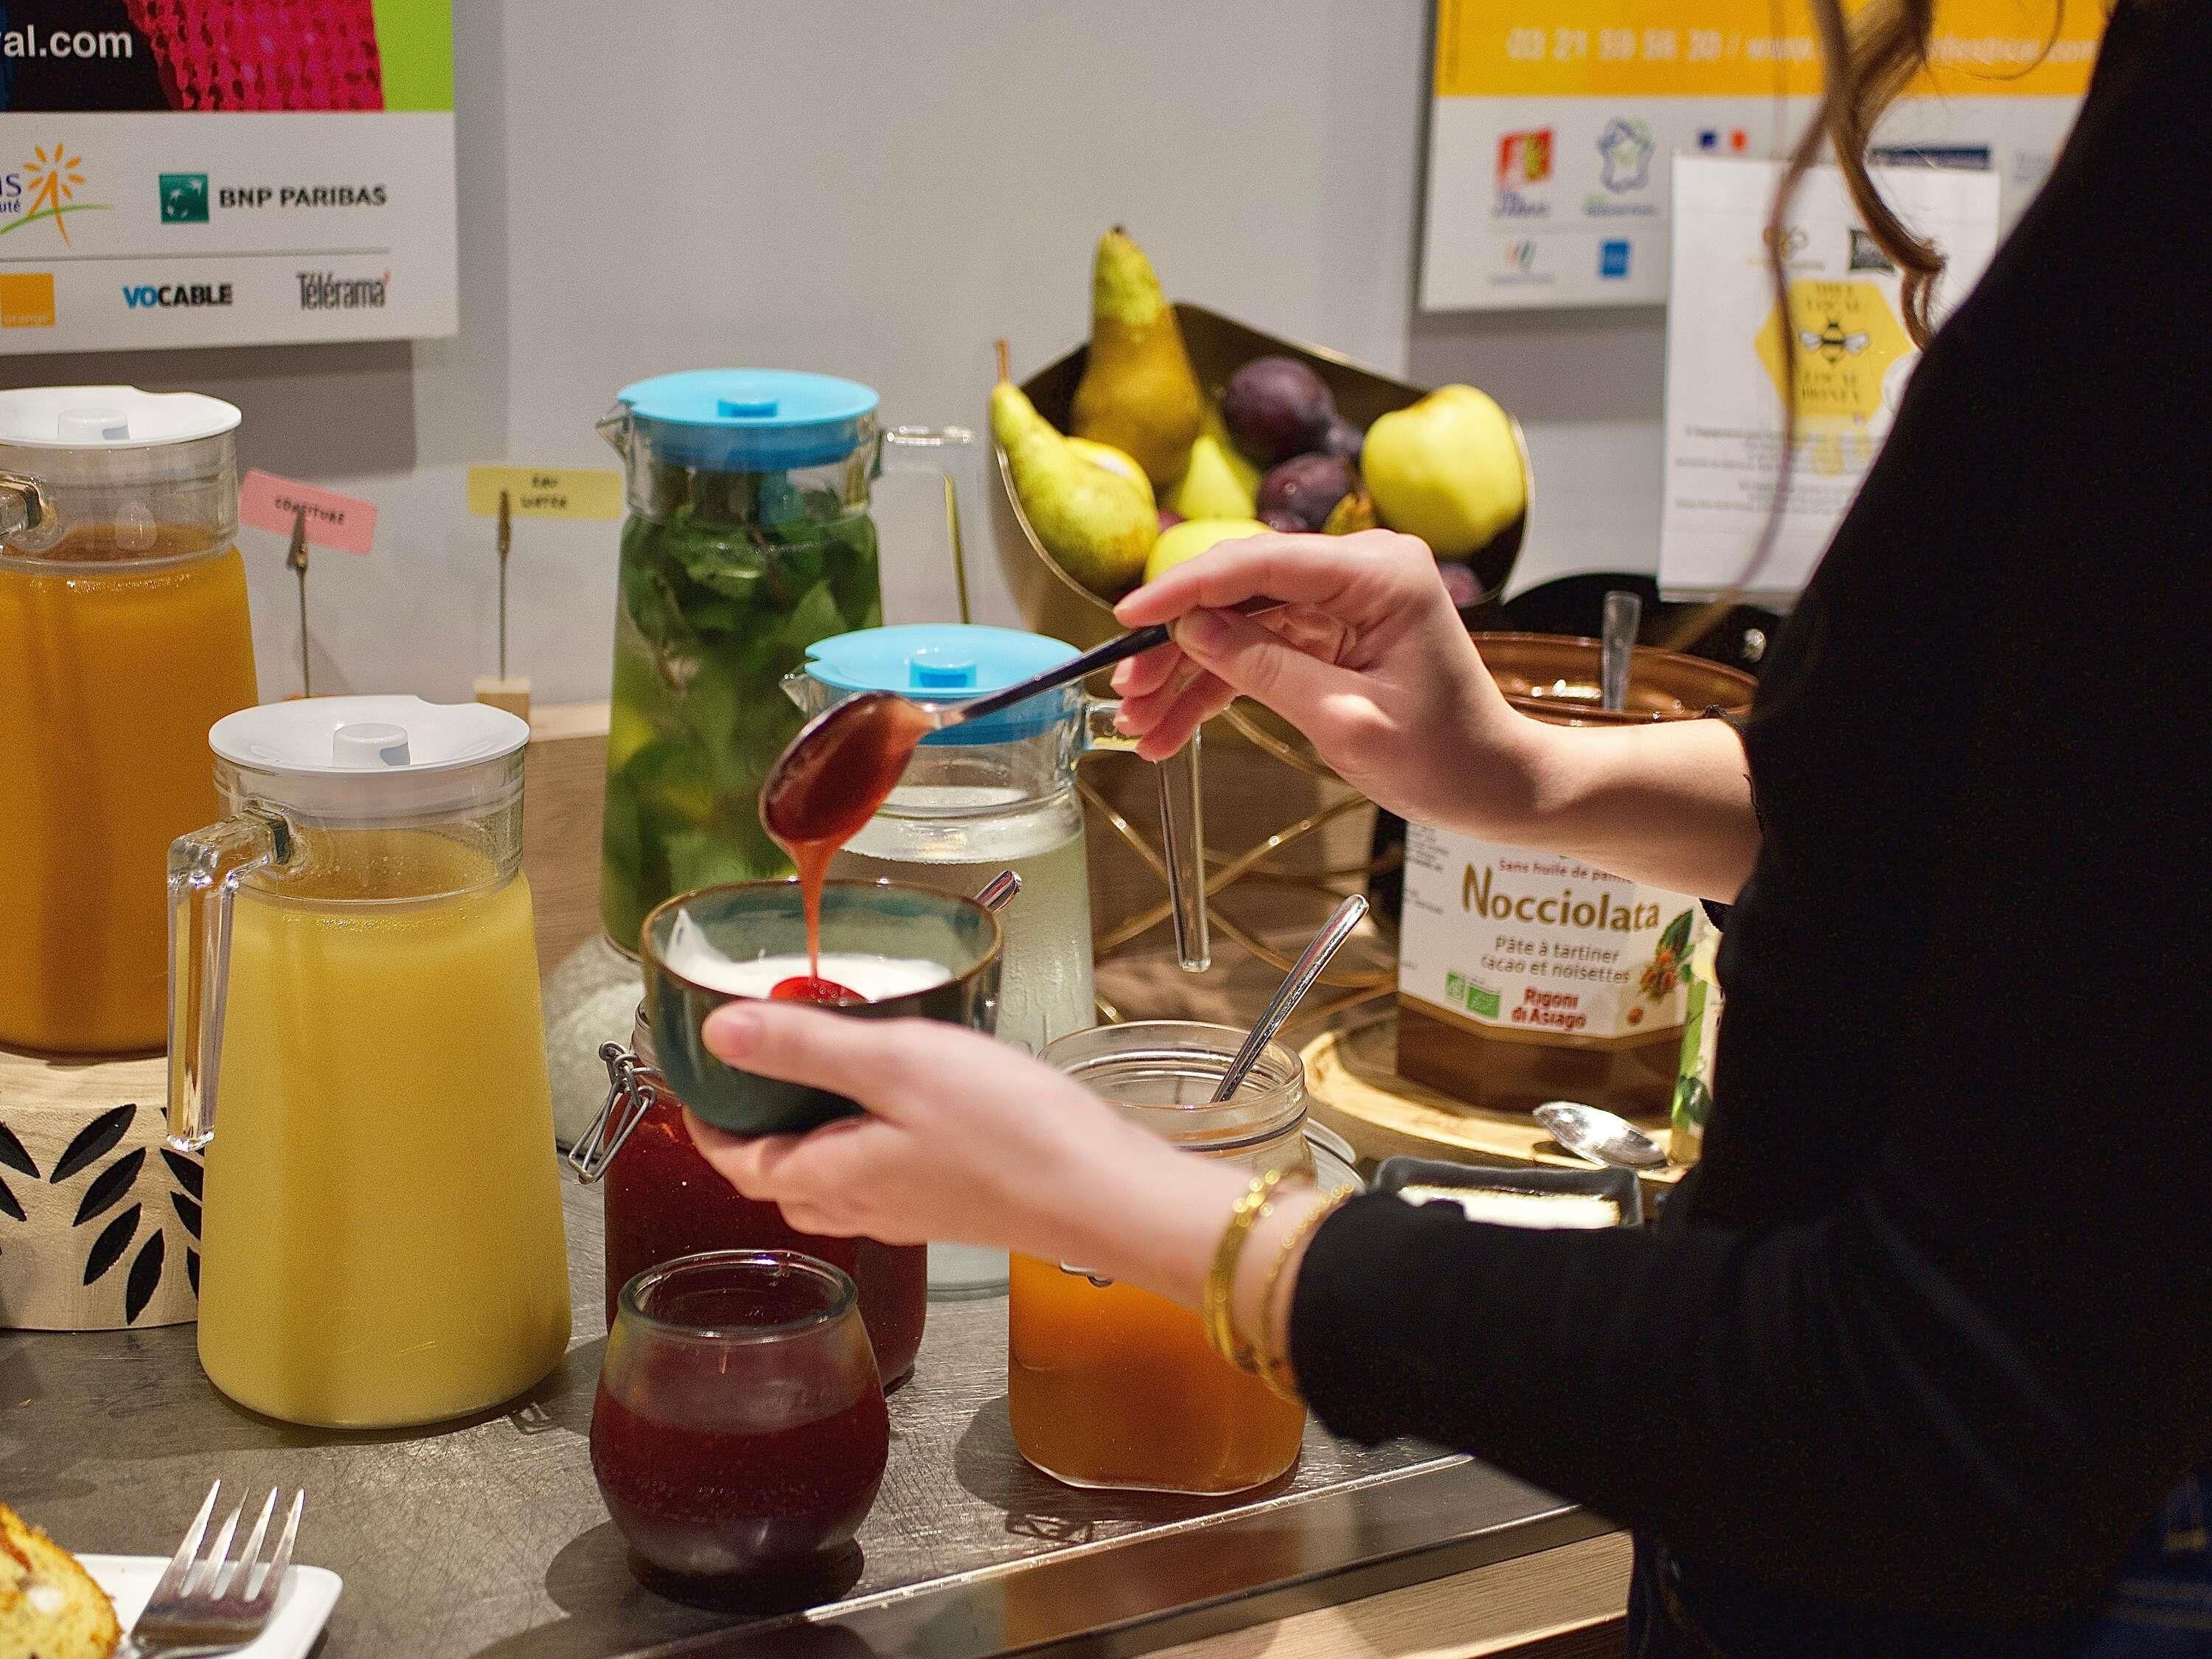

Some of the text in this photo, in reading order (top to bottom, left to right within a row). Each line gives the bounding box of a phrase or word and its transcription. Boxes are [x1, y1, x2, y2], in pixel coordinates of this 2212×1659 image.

[0, 24, 133, 58] al.com
[220, 184, 388, 209] BNP PARIBAS
[122, 282, 234, 310] VOCABLE
[1499, 858, 1529, 873] Sans
[1571, 866, 1589, 879] de
[1462, 863, 1660, 932] Nocciolata
[1495, 935, 1621, 964] Pâte à tartiner
[1530, 961, 1548, 976] et
[1551, 964, 1630, 984] noisettes
[1525, 987, 1579, 1009] Rigoni
